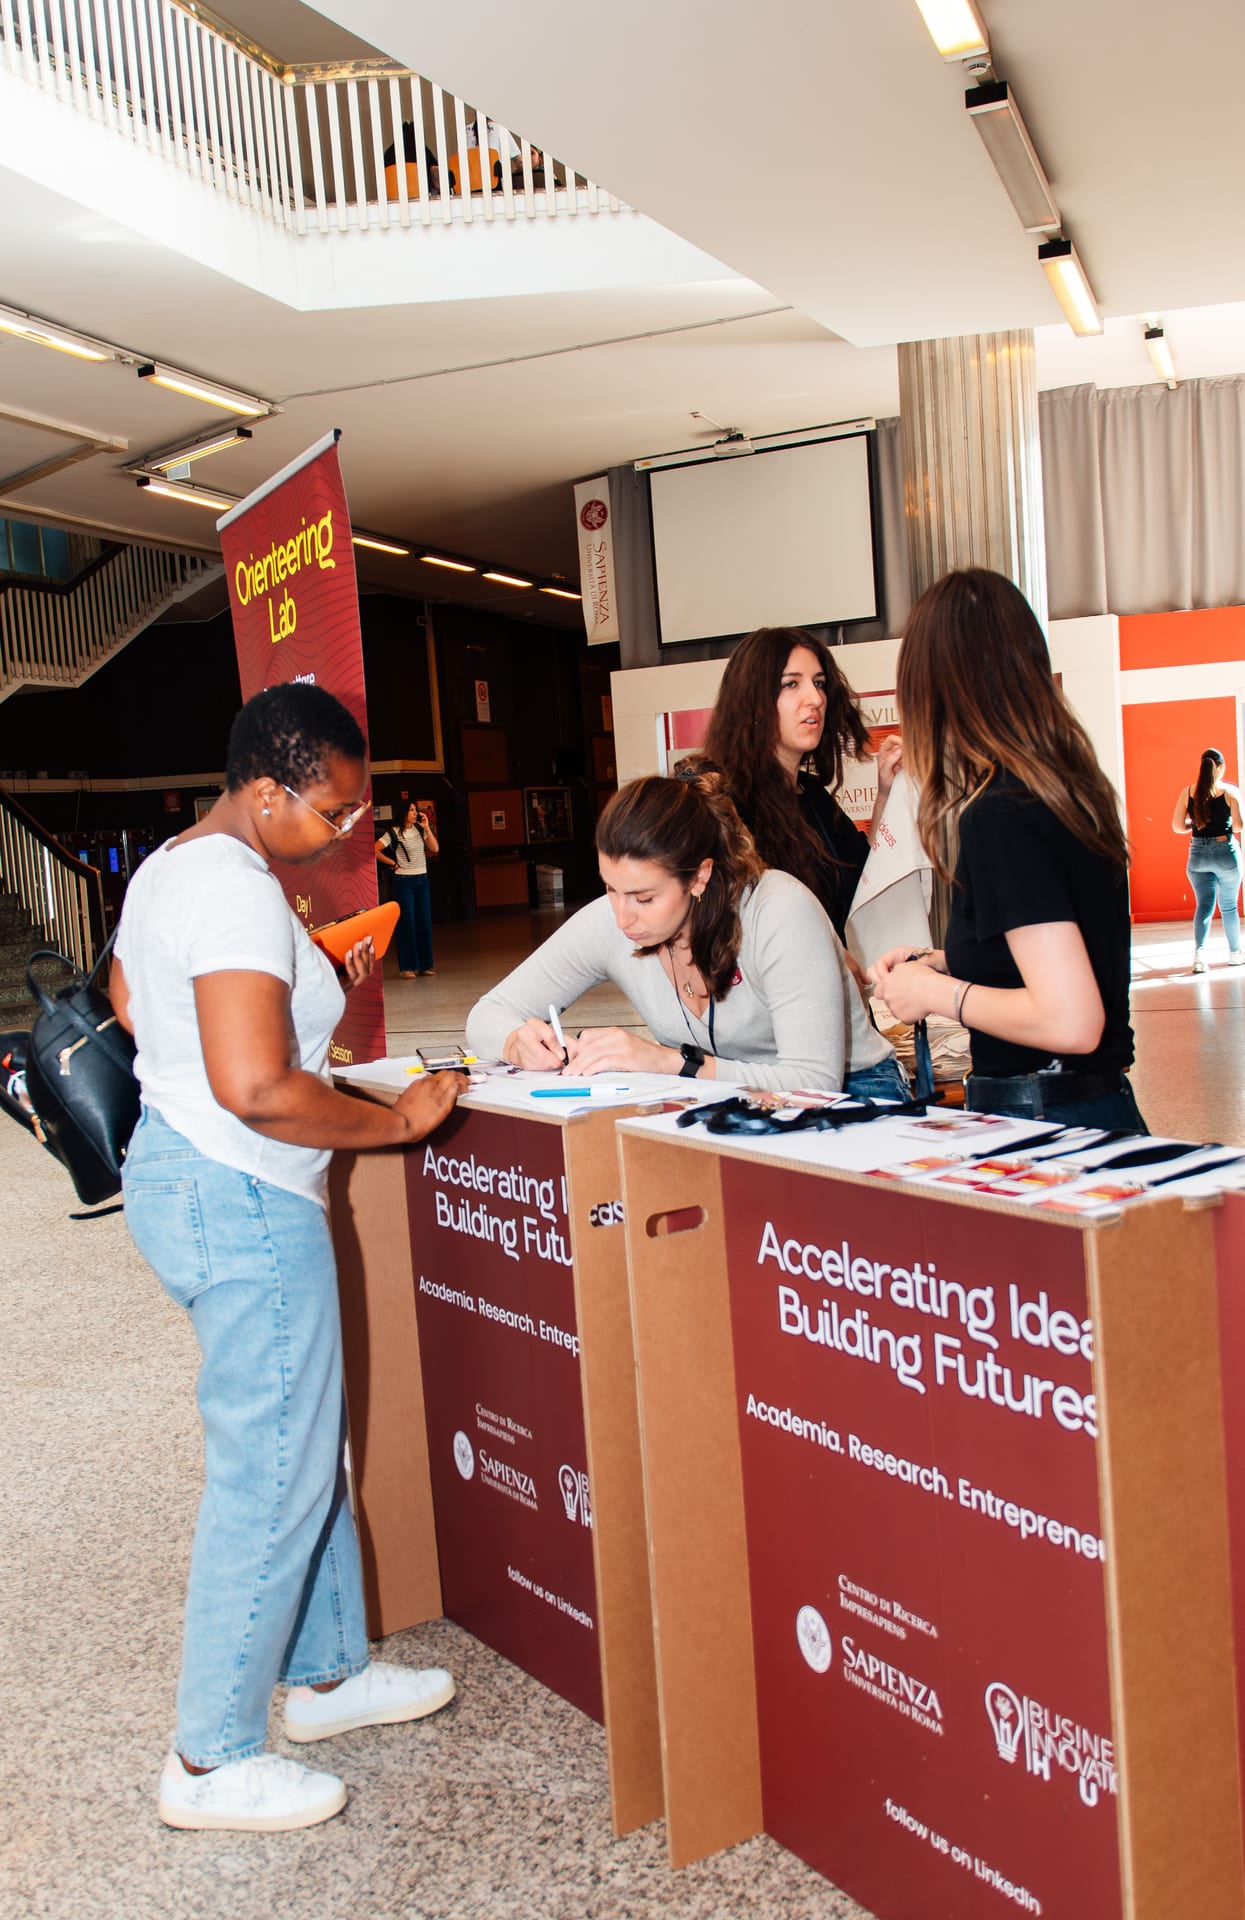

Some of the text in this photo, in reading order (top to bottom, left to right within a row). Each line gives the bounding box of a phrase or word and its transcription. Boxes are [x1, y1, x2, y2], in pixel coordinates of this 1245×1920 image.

[235, 510, 336, 606] Orienteering
[592, 541, 610, 624] SAPIENZA
[268, 587, 297, 643] Lab
[296, 895, 309, 919] Day
[330, 1040, 353, 1065] Session
[422, 1144, 557, 1223] Accelerating
[435, 1191, 520, 1262] Building
[418, 1275, 477, 1313] Academia.
[478, 1297, 537, 1337] Research.
[757, 1221, 999, 1350] Accelerating
[778, 1284, 926, 1395] Building
[479, 1449, 538, 1499] SAPIENZA
[745, 1393, 845, 1456] Academia.
[848, 1433, 954, 1501] Research.
[507, 1564, 532, 1591] follow
[533, 1583, 544, 1599] us
[544, 1591, 557, 1607] on
[841, 1635, 943, 1720] SAPIENZA
[911, 1705, 944, 1736] ROMA
[885, 1797, 928, 1840] follow
[930, 1830, 950, 1855] us
[951, 1846, 972, 1871] on
